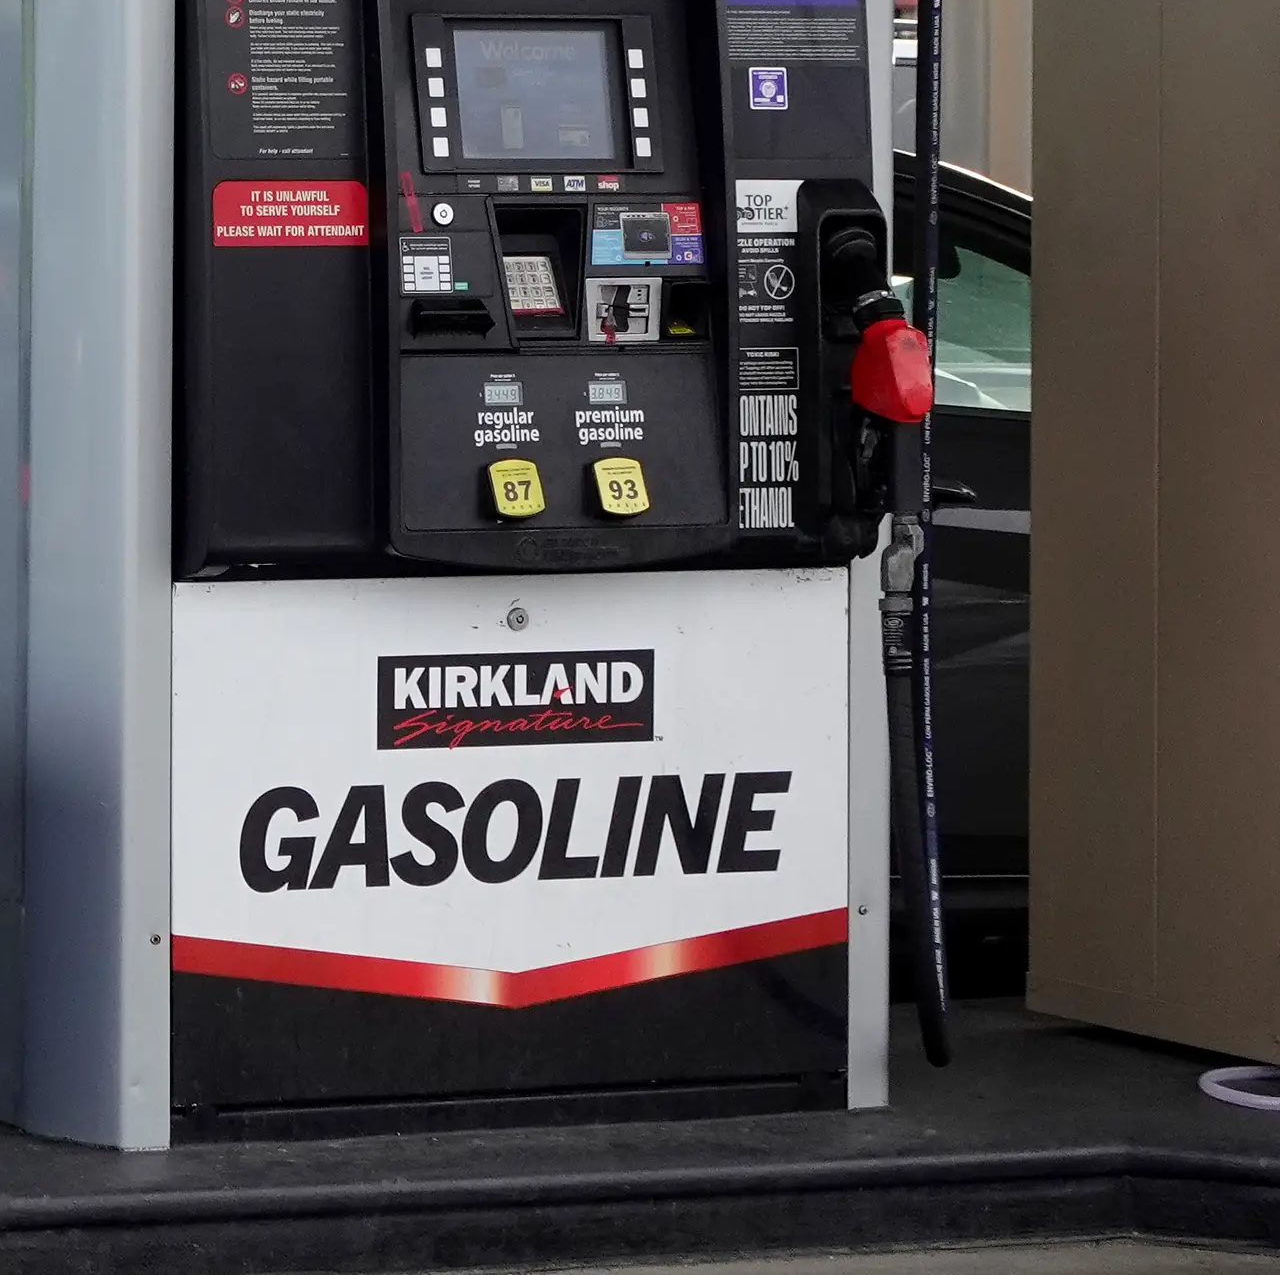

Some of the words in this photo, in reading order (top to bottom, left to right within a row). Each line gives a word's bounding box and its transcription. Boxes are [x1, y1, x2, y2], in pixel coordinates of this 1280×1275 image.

[480, 40, 578, 61] Welcome
[251, 191, 261, 202] IT
[263, 191, 273, 202] IS
[276, 191, 329, 202] UNLAWFUL
[533, 180, 550, 188] VISA
[566, 179, 584, 189] ATM
[598, 181, 619, 192] shop
[240, 205, 254, 216] TO
[256, 205, 288, 216] SERVE
[290, 205, 340, 216] YOURSELF
[745, 194, 772, 207] TOP
[755, 207, 784, 220] TIER
[216, 225, 255, 237] PLEASE
[257, 225, 282, 237] WAIT
[285, 226, 305, 237] FOR
[307, 225, 364, 237] ATTENDANT
[753, 238, 796, 247] OPERATION
[477, 407, 534, 429] regular
[575, 406, 645, 427] premium
[739, 395, 798, 437] ONTAINS
[474, 425, 540, 447] gasoline
[578, 424, 644, 445] gasoline
[750, 441, 768, 483] TO
[769, 440, 800, 483] 10%
[503, 480, 532, 503] 87
[608, 479, 639, 501] 93
[739, 486, 795, 529] ETHANOL
[394, 661, 645, 710] KIRKLAND
[393, 708, 644, 749] Signature
[239, 770, 793, 893] GASOLINE
